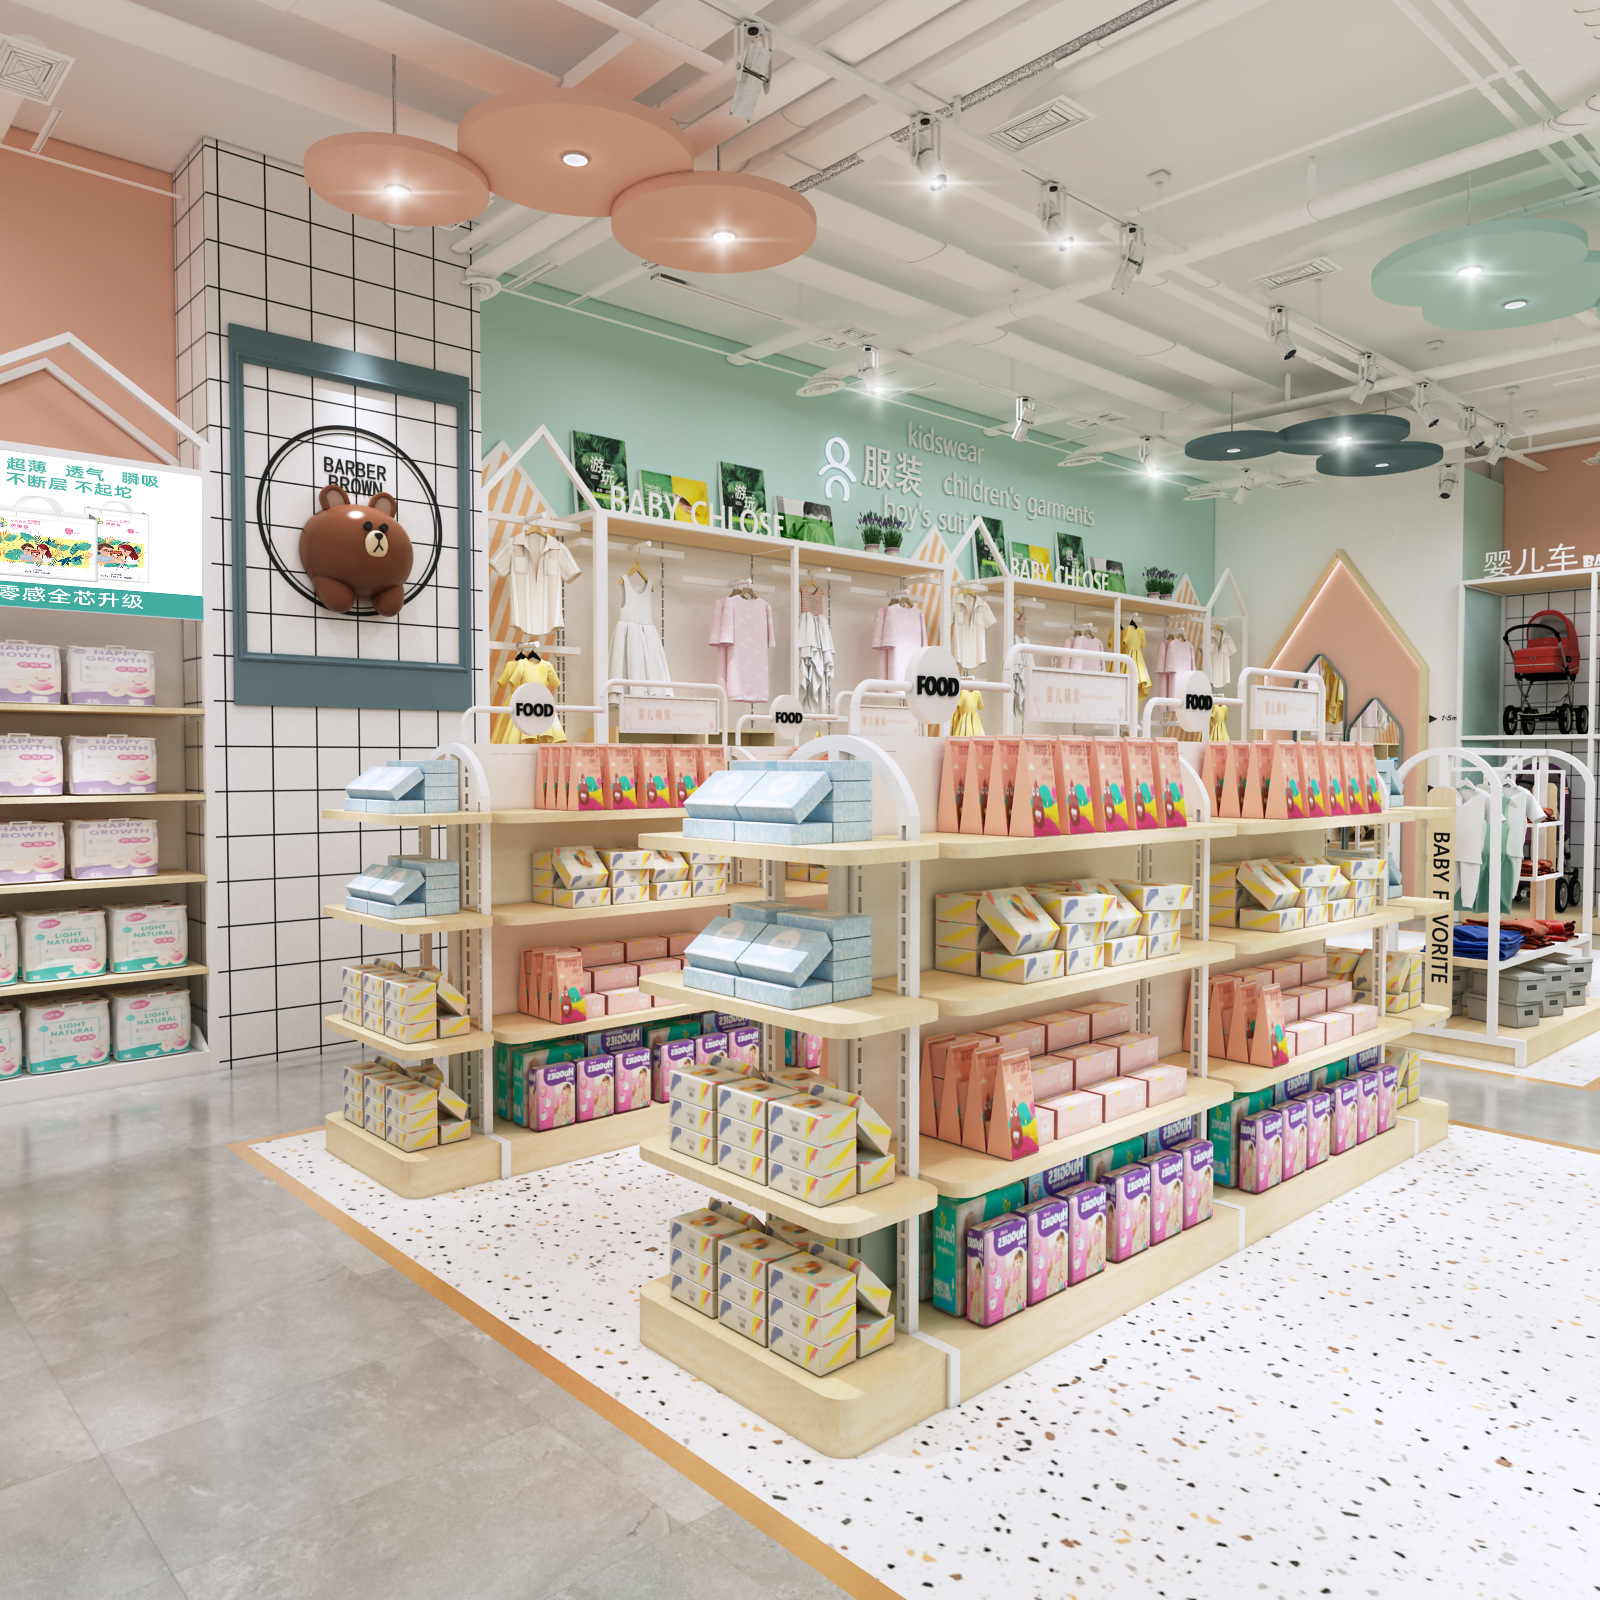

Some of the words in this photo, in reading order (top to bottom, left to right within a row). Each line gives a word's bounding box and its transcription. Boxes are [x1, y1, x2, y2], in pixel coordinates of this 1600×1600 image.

[907, 421, 984, 464] kidswear
[6, 457, 47, 474] 超薄
[65, 465, 105, 482] 透气
[122, 471, 159, 489] 瞬吸
[323, 456, 386, 481] BARBER
[861, 445, 923, 497] 服装
[6, 472, 68, 491] 不断层
[610, 485, 682, 520] BABY
[943, 472, 1021, 510] children's
[1026, 496, 1095, 527] garments
[937, 510, 968, 535] suit
[1010, 557, 1050, 581] BABY
[1484, 543, 1578, 579] 婴儿车
[0, 584, 144, 609] 零感全芯升级
[86, 655, 147, 664] GROWTH
[94, 649, 139, 657] HAPPY
[917, 675, 960, 697] FOOD
[515, 703, 554, 717] FOOD
[1186, 694, 1213, 711] FOOD
[775, 711, 803, 724] FOOD
[89, 827, 150, 836] GROWTH
[1432, 832, 1450, 883] BABY
[54, 930, 82, 939] LIGHT
[133, 929, 175, 938] NATURAL
[140, 923, 167, 931] LIGHT
[46, 936, 91, 946] NATURAL
[1431, 890, 1450, 984] FVORITE
[136, 1015, 178, 1025] NATURAL
[144, 1010, 170, 1018] LIGHT
[50, 1027, 94, 1037] NATURAL
[58, 1021, 86, 1030] LIGHT
